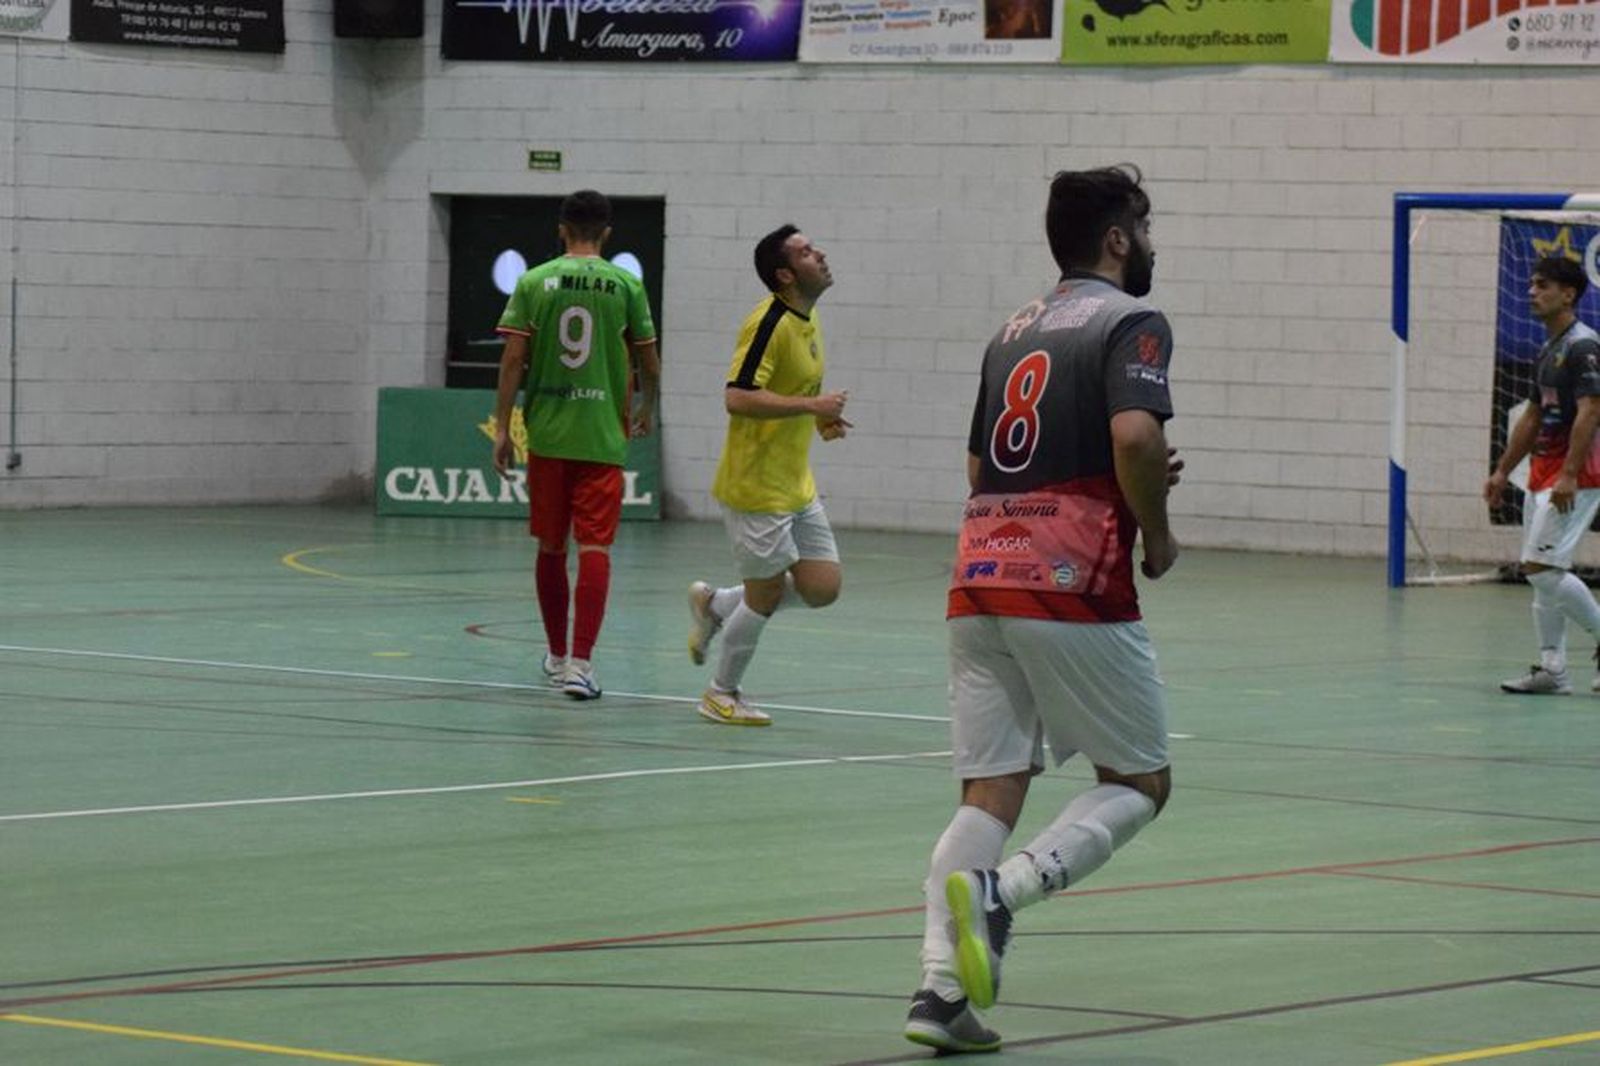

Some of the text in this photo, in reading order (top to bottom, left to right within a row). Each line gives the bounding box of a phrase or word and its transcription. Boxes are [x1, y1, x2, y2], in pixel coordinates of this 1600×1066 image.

[938, 8, 976, 26] Epoc
[581, 22, 743, 57] Amargura, 10
[1106, 30, 1289, 50] www.sferagraficas.com
[561, 275, 617, 294] MILAR
[559, 305, 593, 369] 9
[990, 349, 1051, 473] 8
